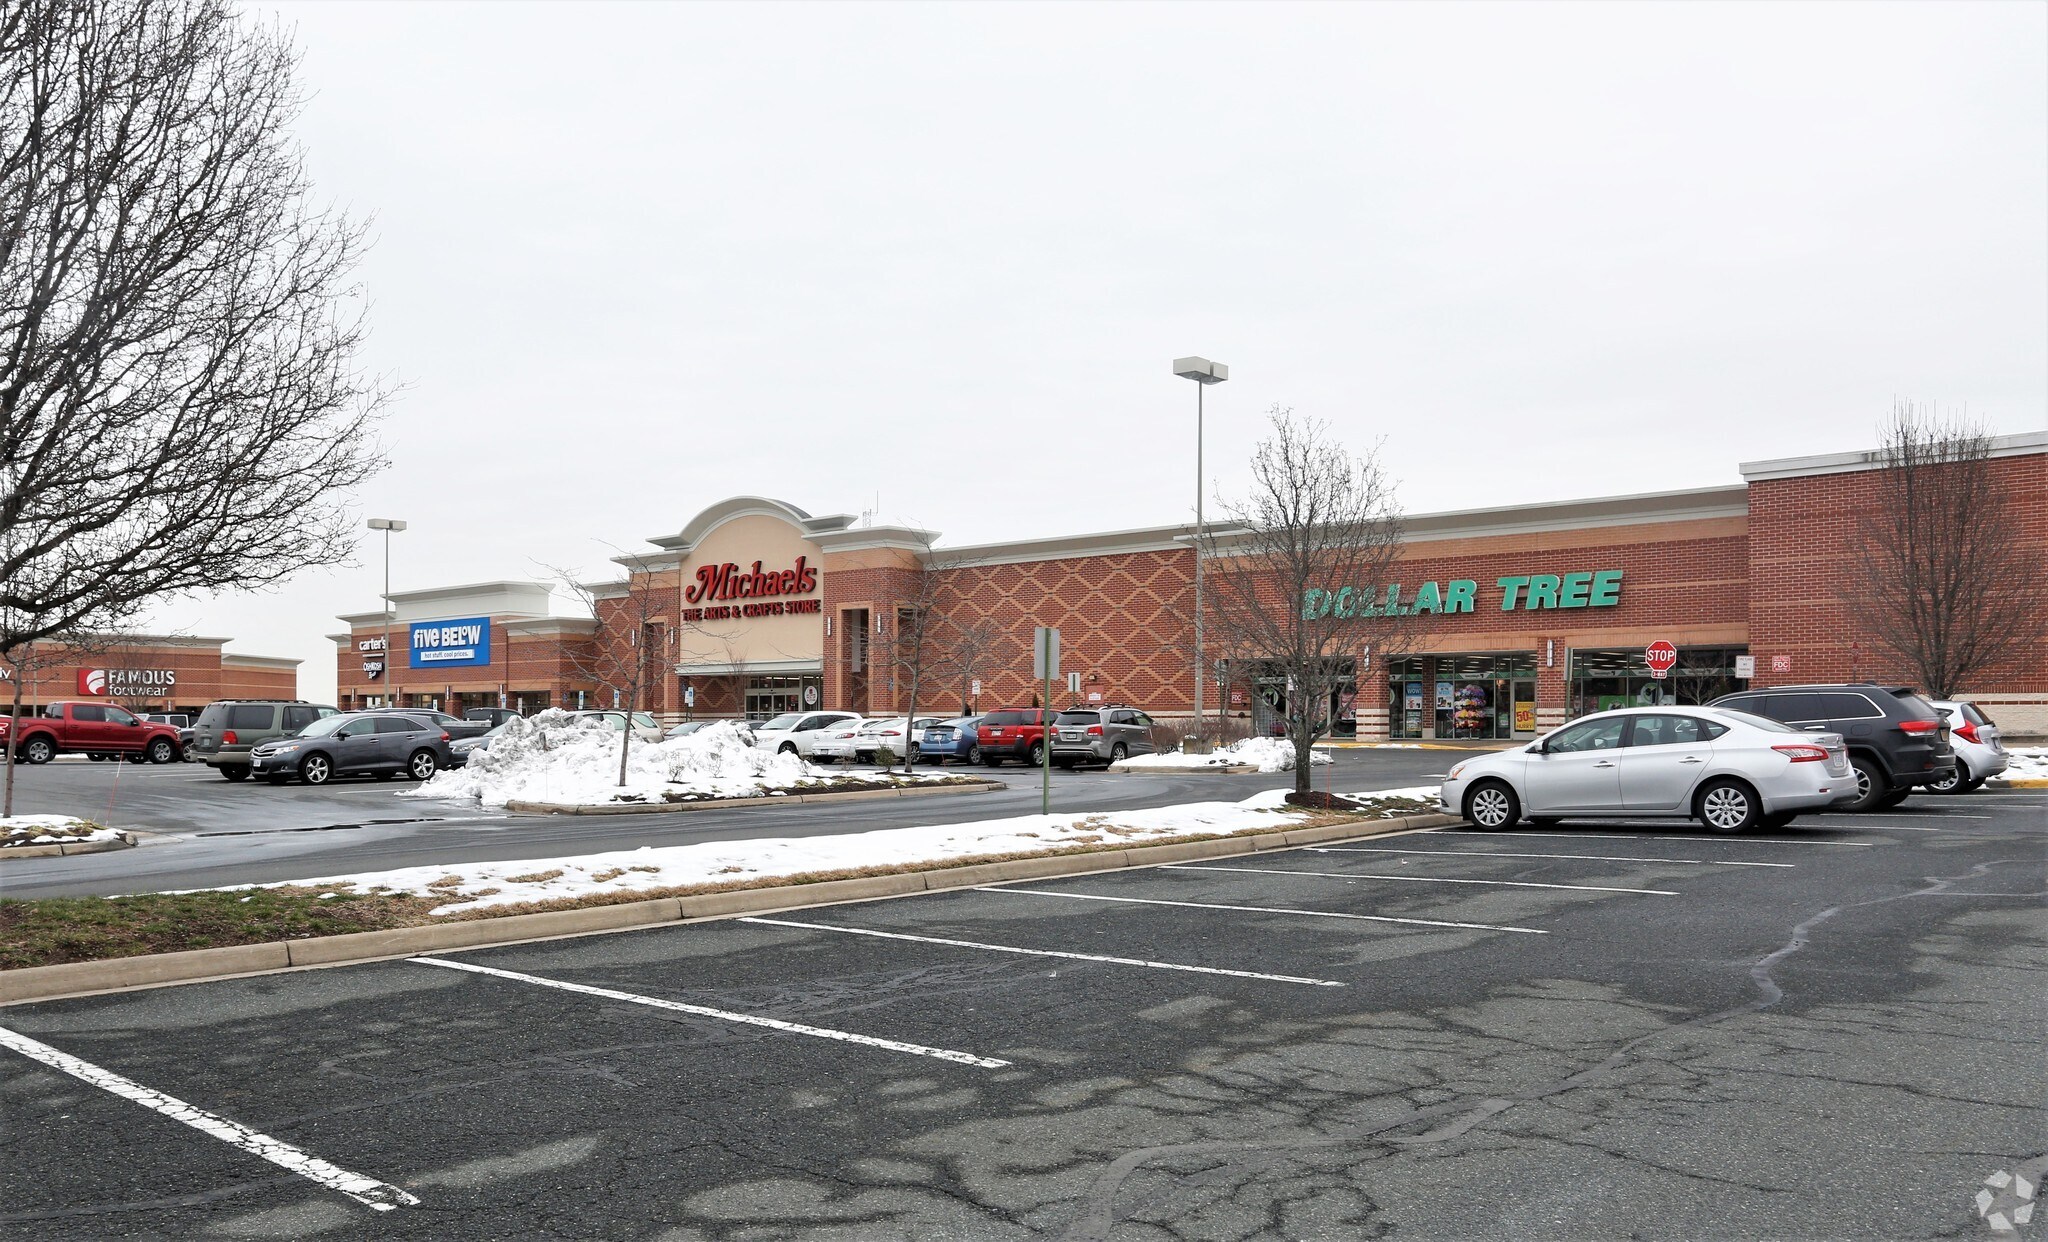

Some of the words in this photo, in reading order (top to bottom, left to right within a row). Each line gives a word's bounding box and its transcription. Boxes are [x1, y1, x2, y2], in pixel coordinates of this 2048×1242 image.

[685, 556, 817, 603] Michaels
[1302, 579, 1478, 620] DOLLAR
[1497, 570, 1624, 611] TREE
[682, 608, 702, 621] THE
[704, 606, 730, 620] ARTS
[731, 605, 741, 618] &
[742, 601, 784, 617] CRAFTS
[785, 599, 821, 614] STORE
[359, 636, 386, 650] carter's
[1647, 650, 1675, 661] STOP
[108, 670, 175, 685] FAMOUS
[109, 684, 167, 696] footwear
